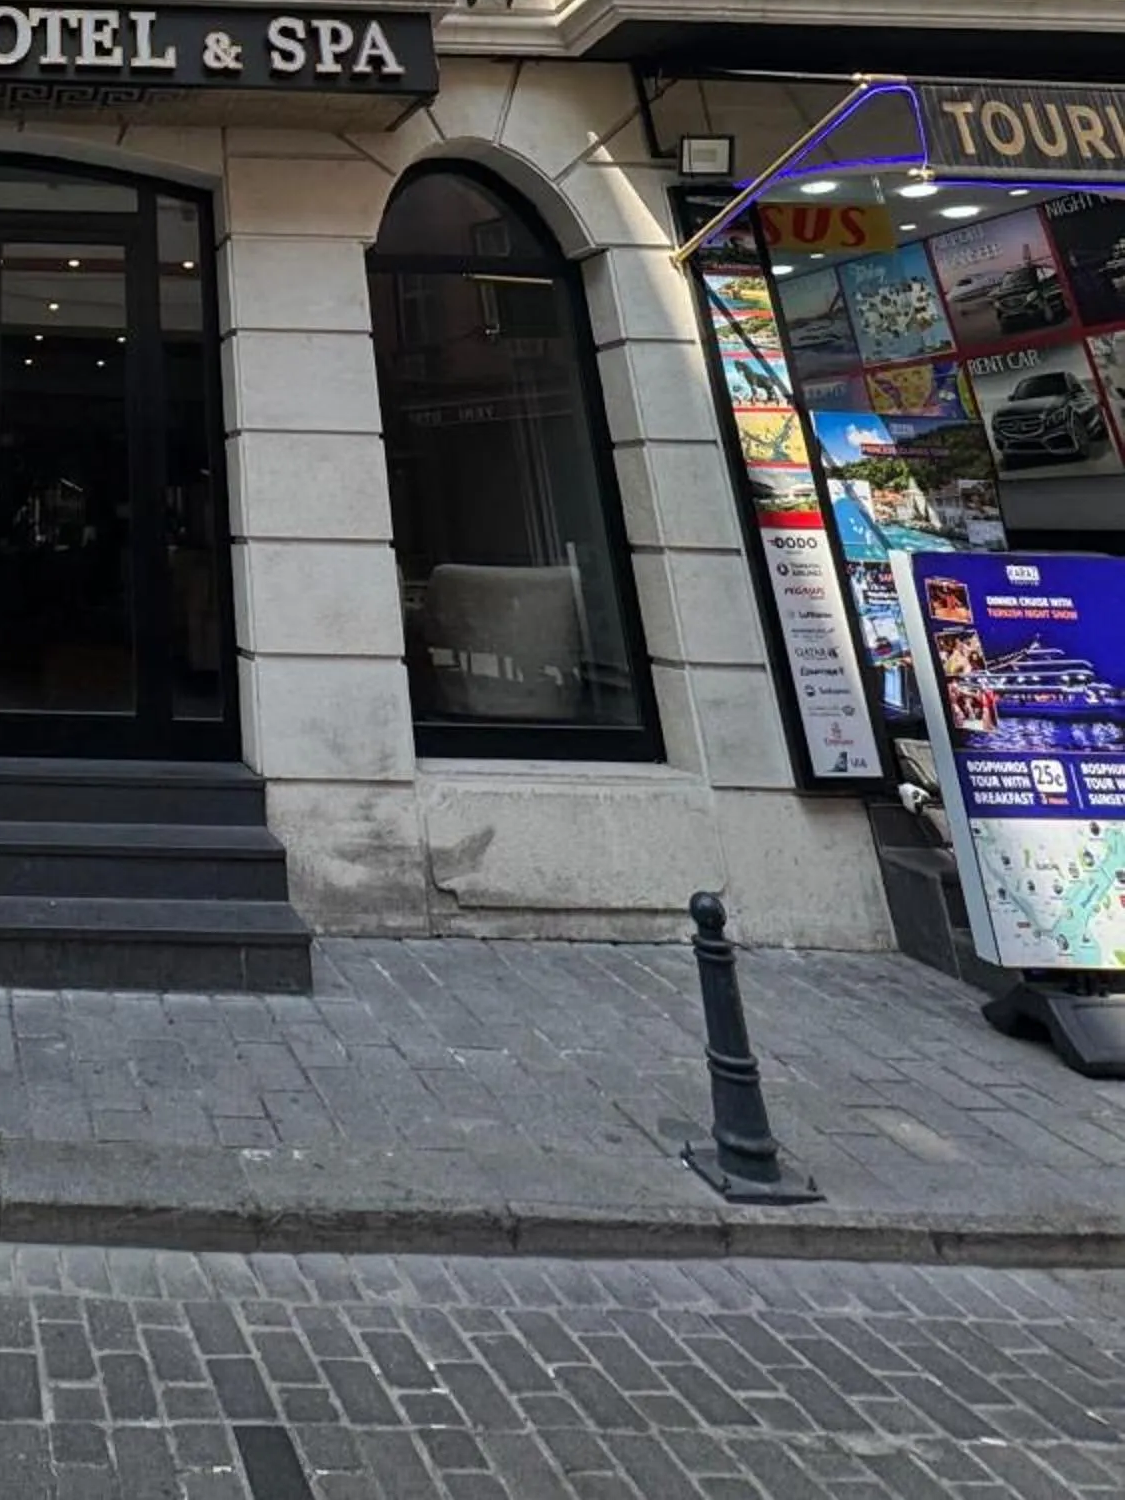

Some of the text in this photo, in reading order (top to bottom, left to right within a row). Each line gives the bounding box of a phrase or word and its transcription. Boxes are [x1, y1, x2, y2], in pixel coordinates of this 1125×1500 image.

[202, 31, 244, 70] &
[267, 15, 406, 74] SPA
[967, 349, 1041, 376] RENT CAR
[969, 775, 1032, 789] TOUR WITH
[1083, 777, 1116, 790] TOUR
[973, 791, 1034, 805] BREAKFAST
